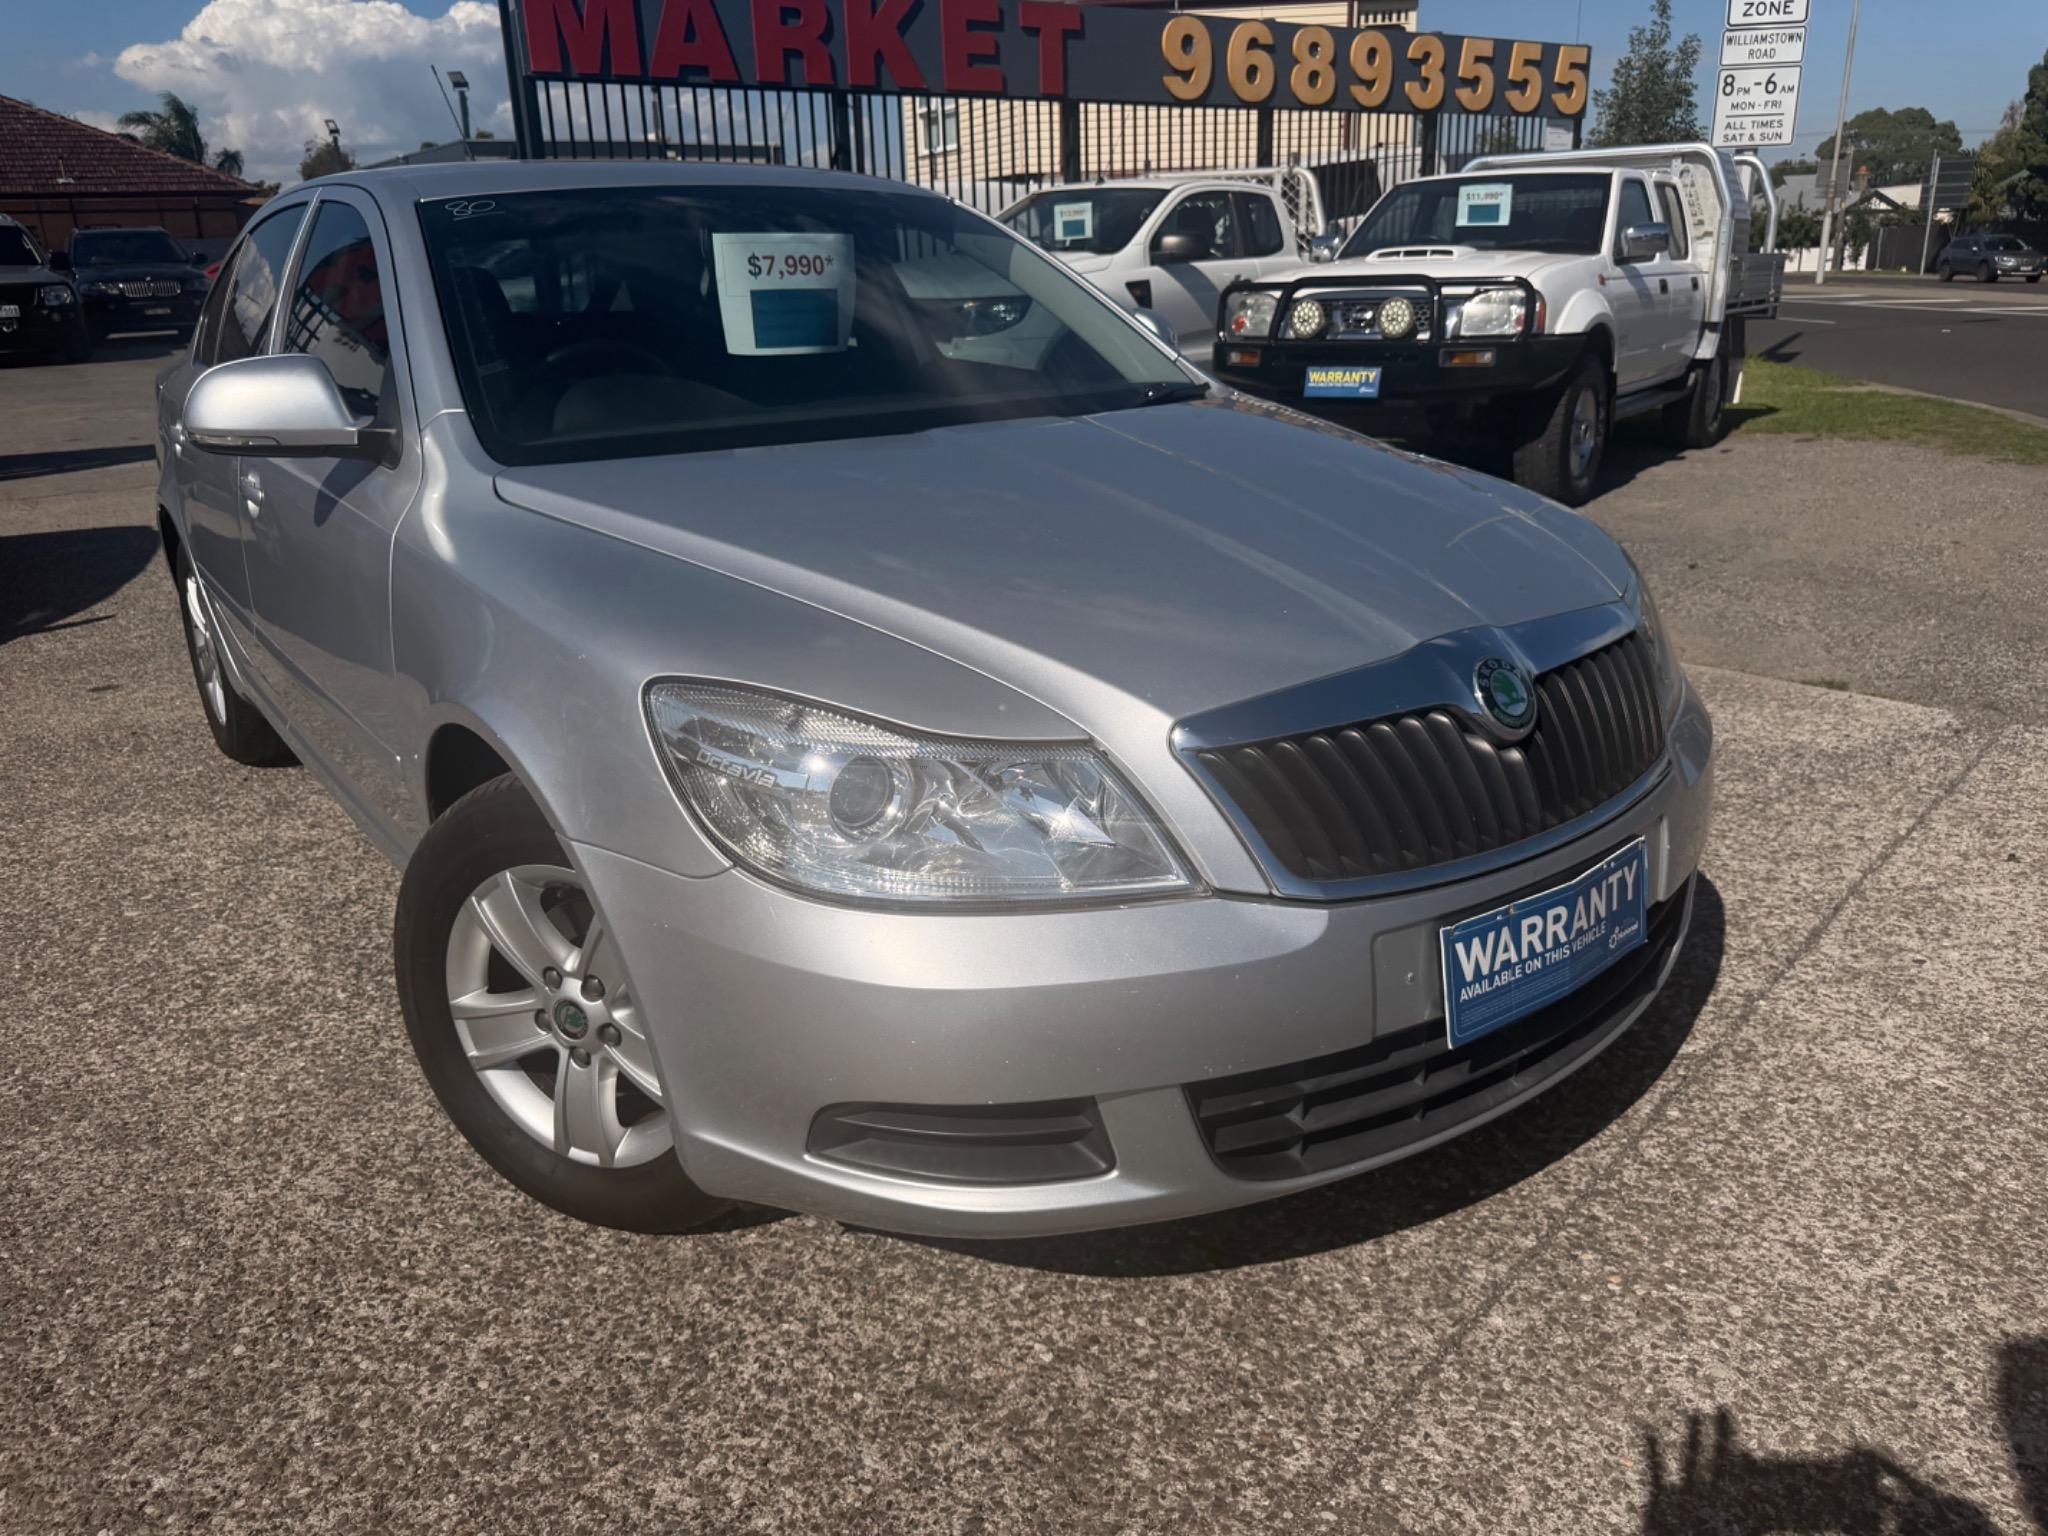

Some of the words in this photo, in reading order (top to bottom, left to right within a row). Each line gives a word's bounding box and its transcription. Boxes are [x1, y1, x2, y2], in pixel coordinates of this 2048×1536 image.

[1742, 0, 1794, 17] ZONE
[1726, 33, 1803, 46] WILLIAMSTOWN
[523, 0, 1083, 95] MARKET
[1748, 48, 1776, 60] ROAD
[1161, 15, 1589, 115] 96893555
[1724, 121, 1746, 131] ALL
[1751, 119, 1784, 129] TIMES
[1723, 133, 1744, 143] SAT
[1748, 132, 1755, 142] &
[1760, 131, 1783, 141] SUN
[1309, 371, 1376, 384] WARRANTY
[1455, 859, 1638, 982] WARRANTY
[1460, 966, 1522, 1002] AVAILABLE
[1525, 955, 1542, 973] ON
[1545, 944, 1570, 966] THIS
[1571, 920, 1606, 953] VEHICLE
